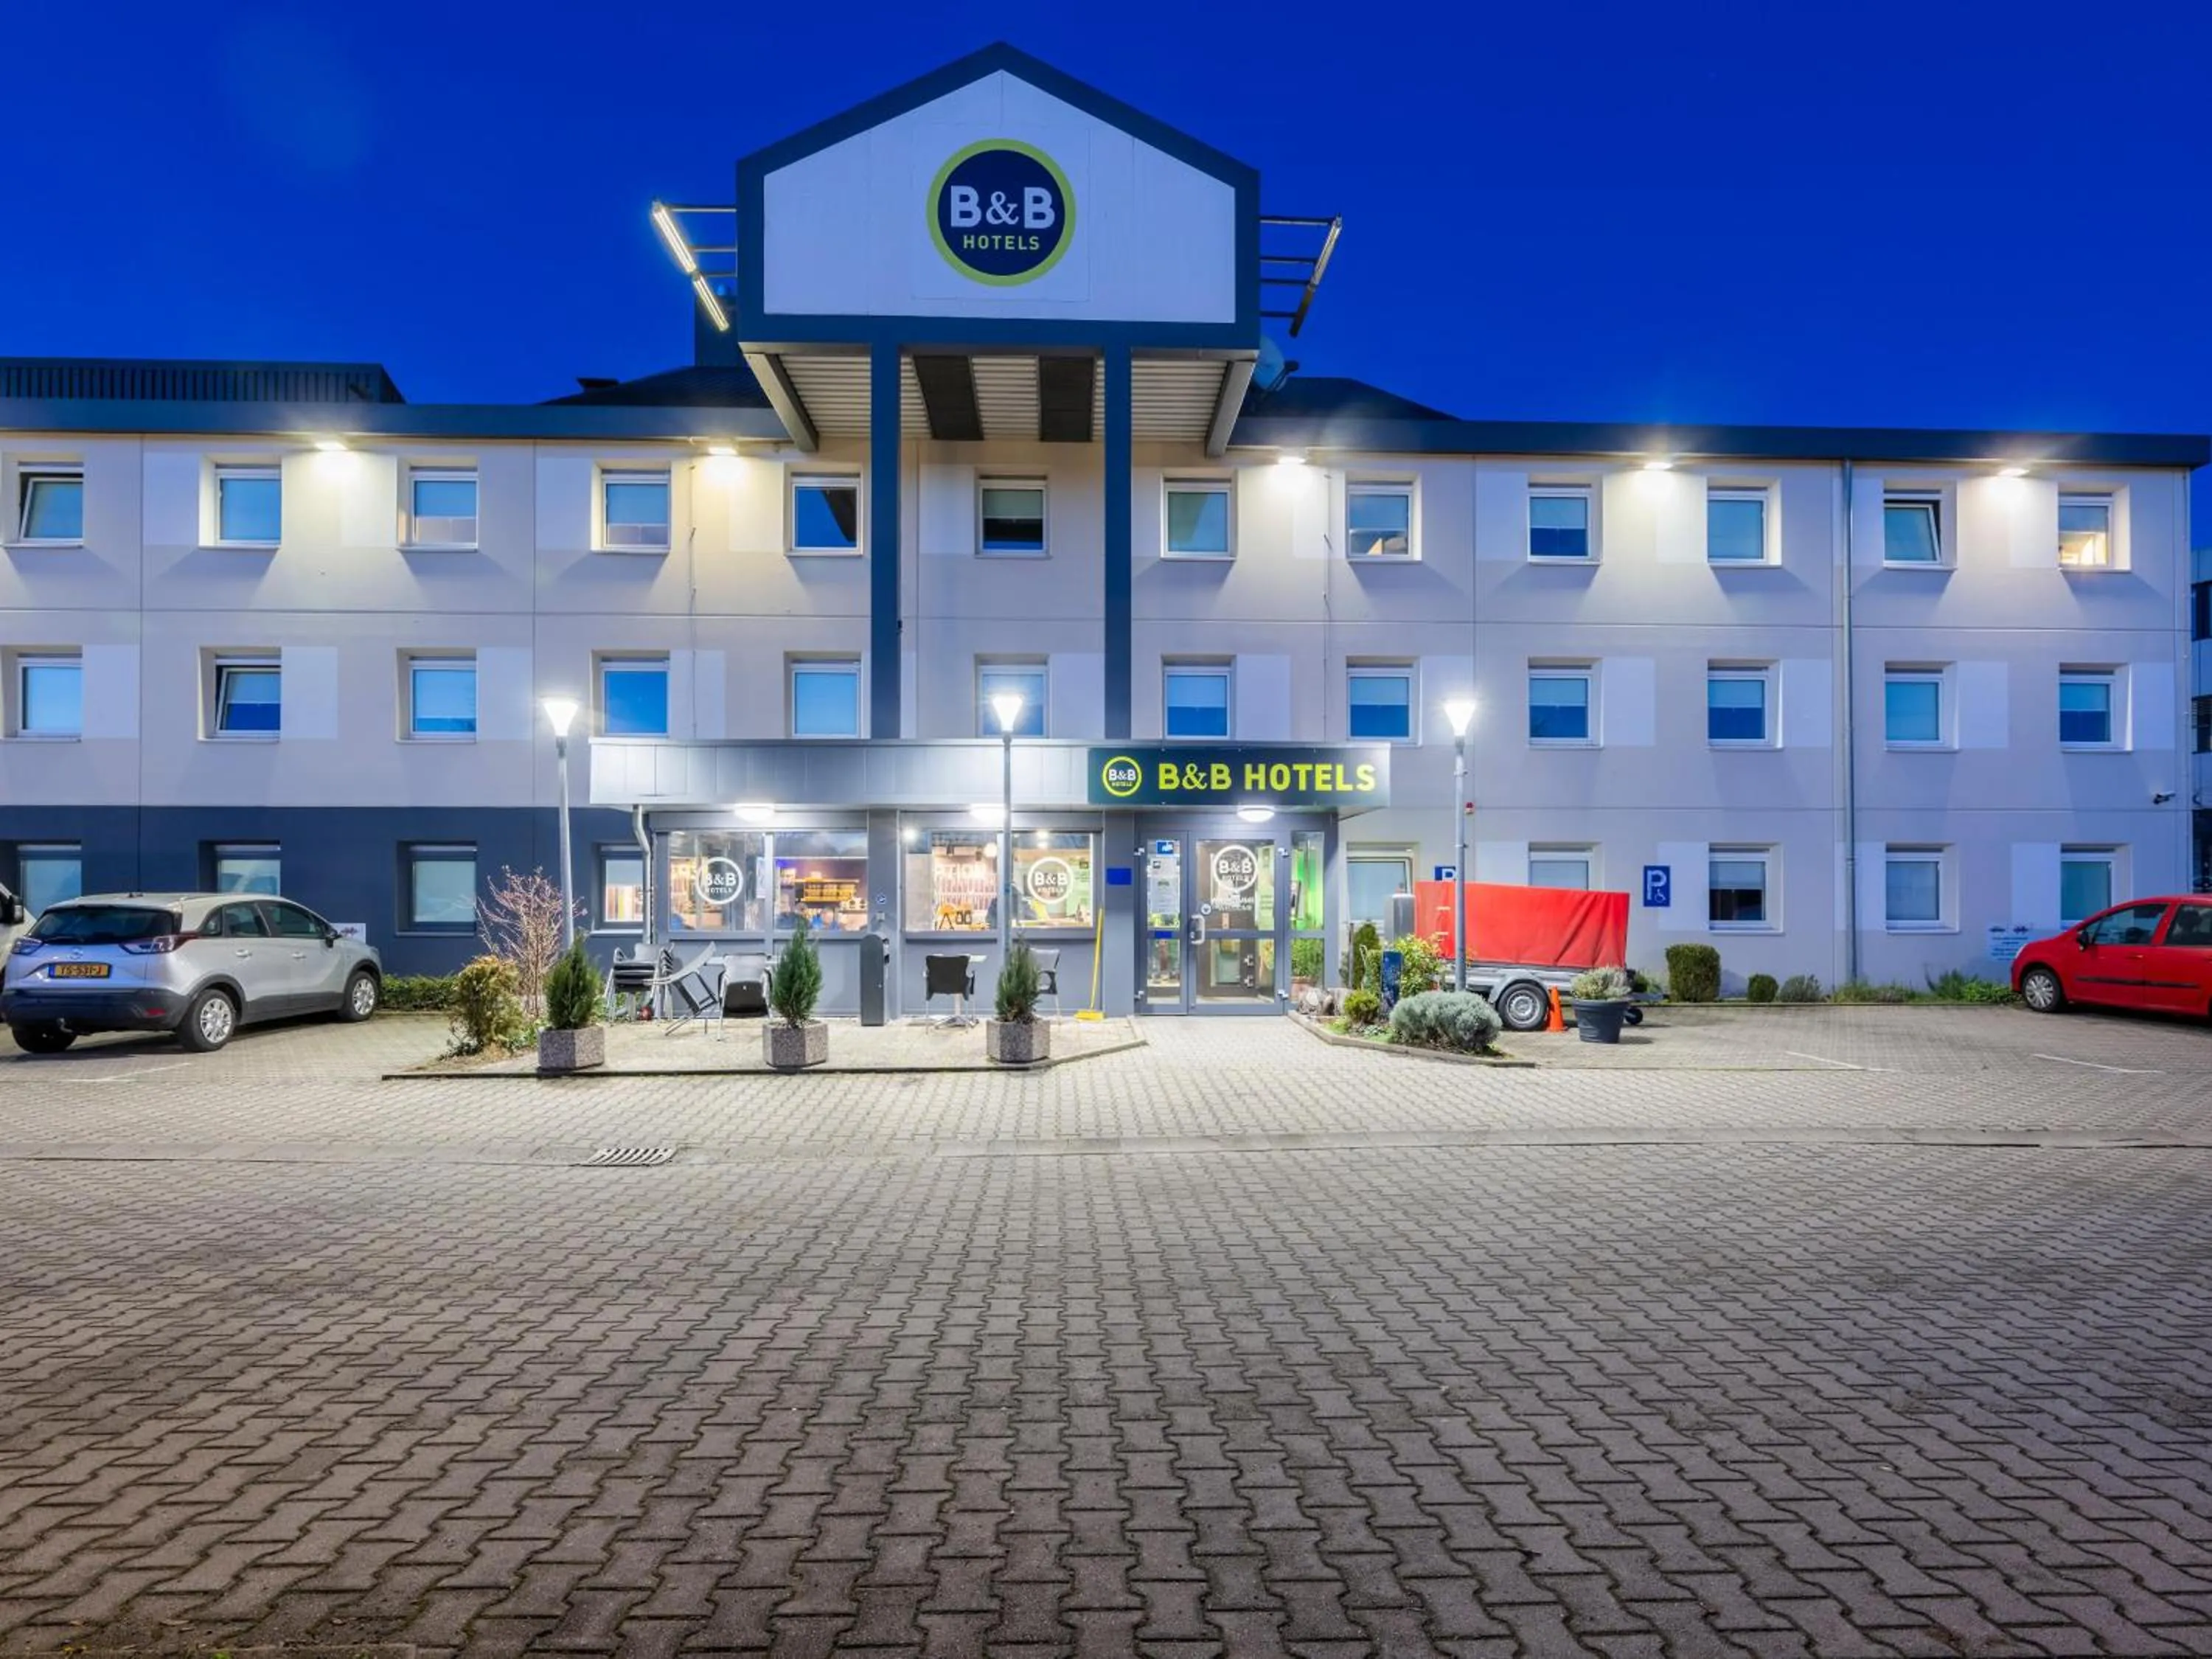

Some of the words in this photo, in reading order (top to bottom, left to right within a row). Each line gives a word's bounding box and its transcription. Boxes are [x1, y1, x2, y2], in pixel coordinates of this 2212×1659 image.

[950, 185, 1055, 229] B&B
[963, 234, 1040, 251] HOTELS
[1108, 769, 1136, 781] B&B
[1158, 762, 1232, 790] B&B
[1244, 762, 1377, 792] HOTELS
[1218, 859, 1252, 874] B&B
[704, 872, 737, 886] B&B
[1034, 872, 1068, 886] B&B
[1646, 870, 1666, 900] P
